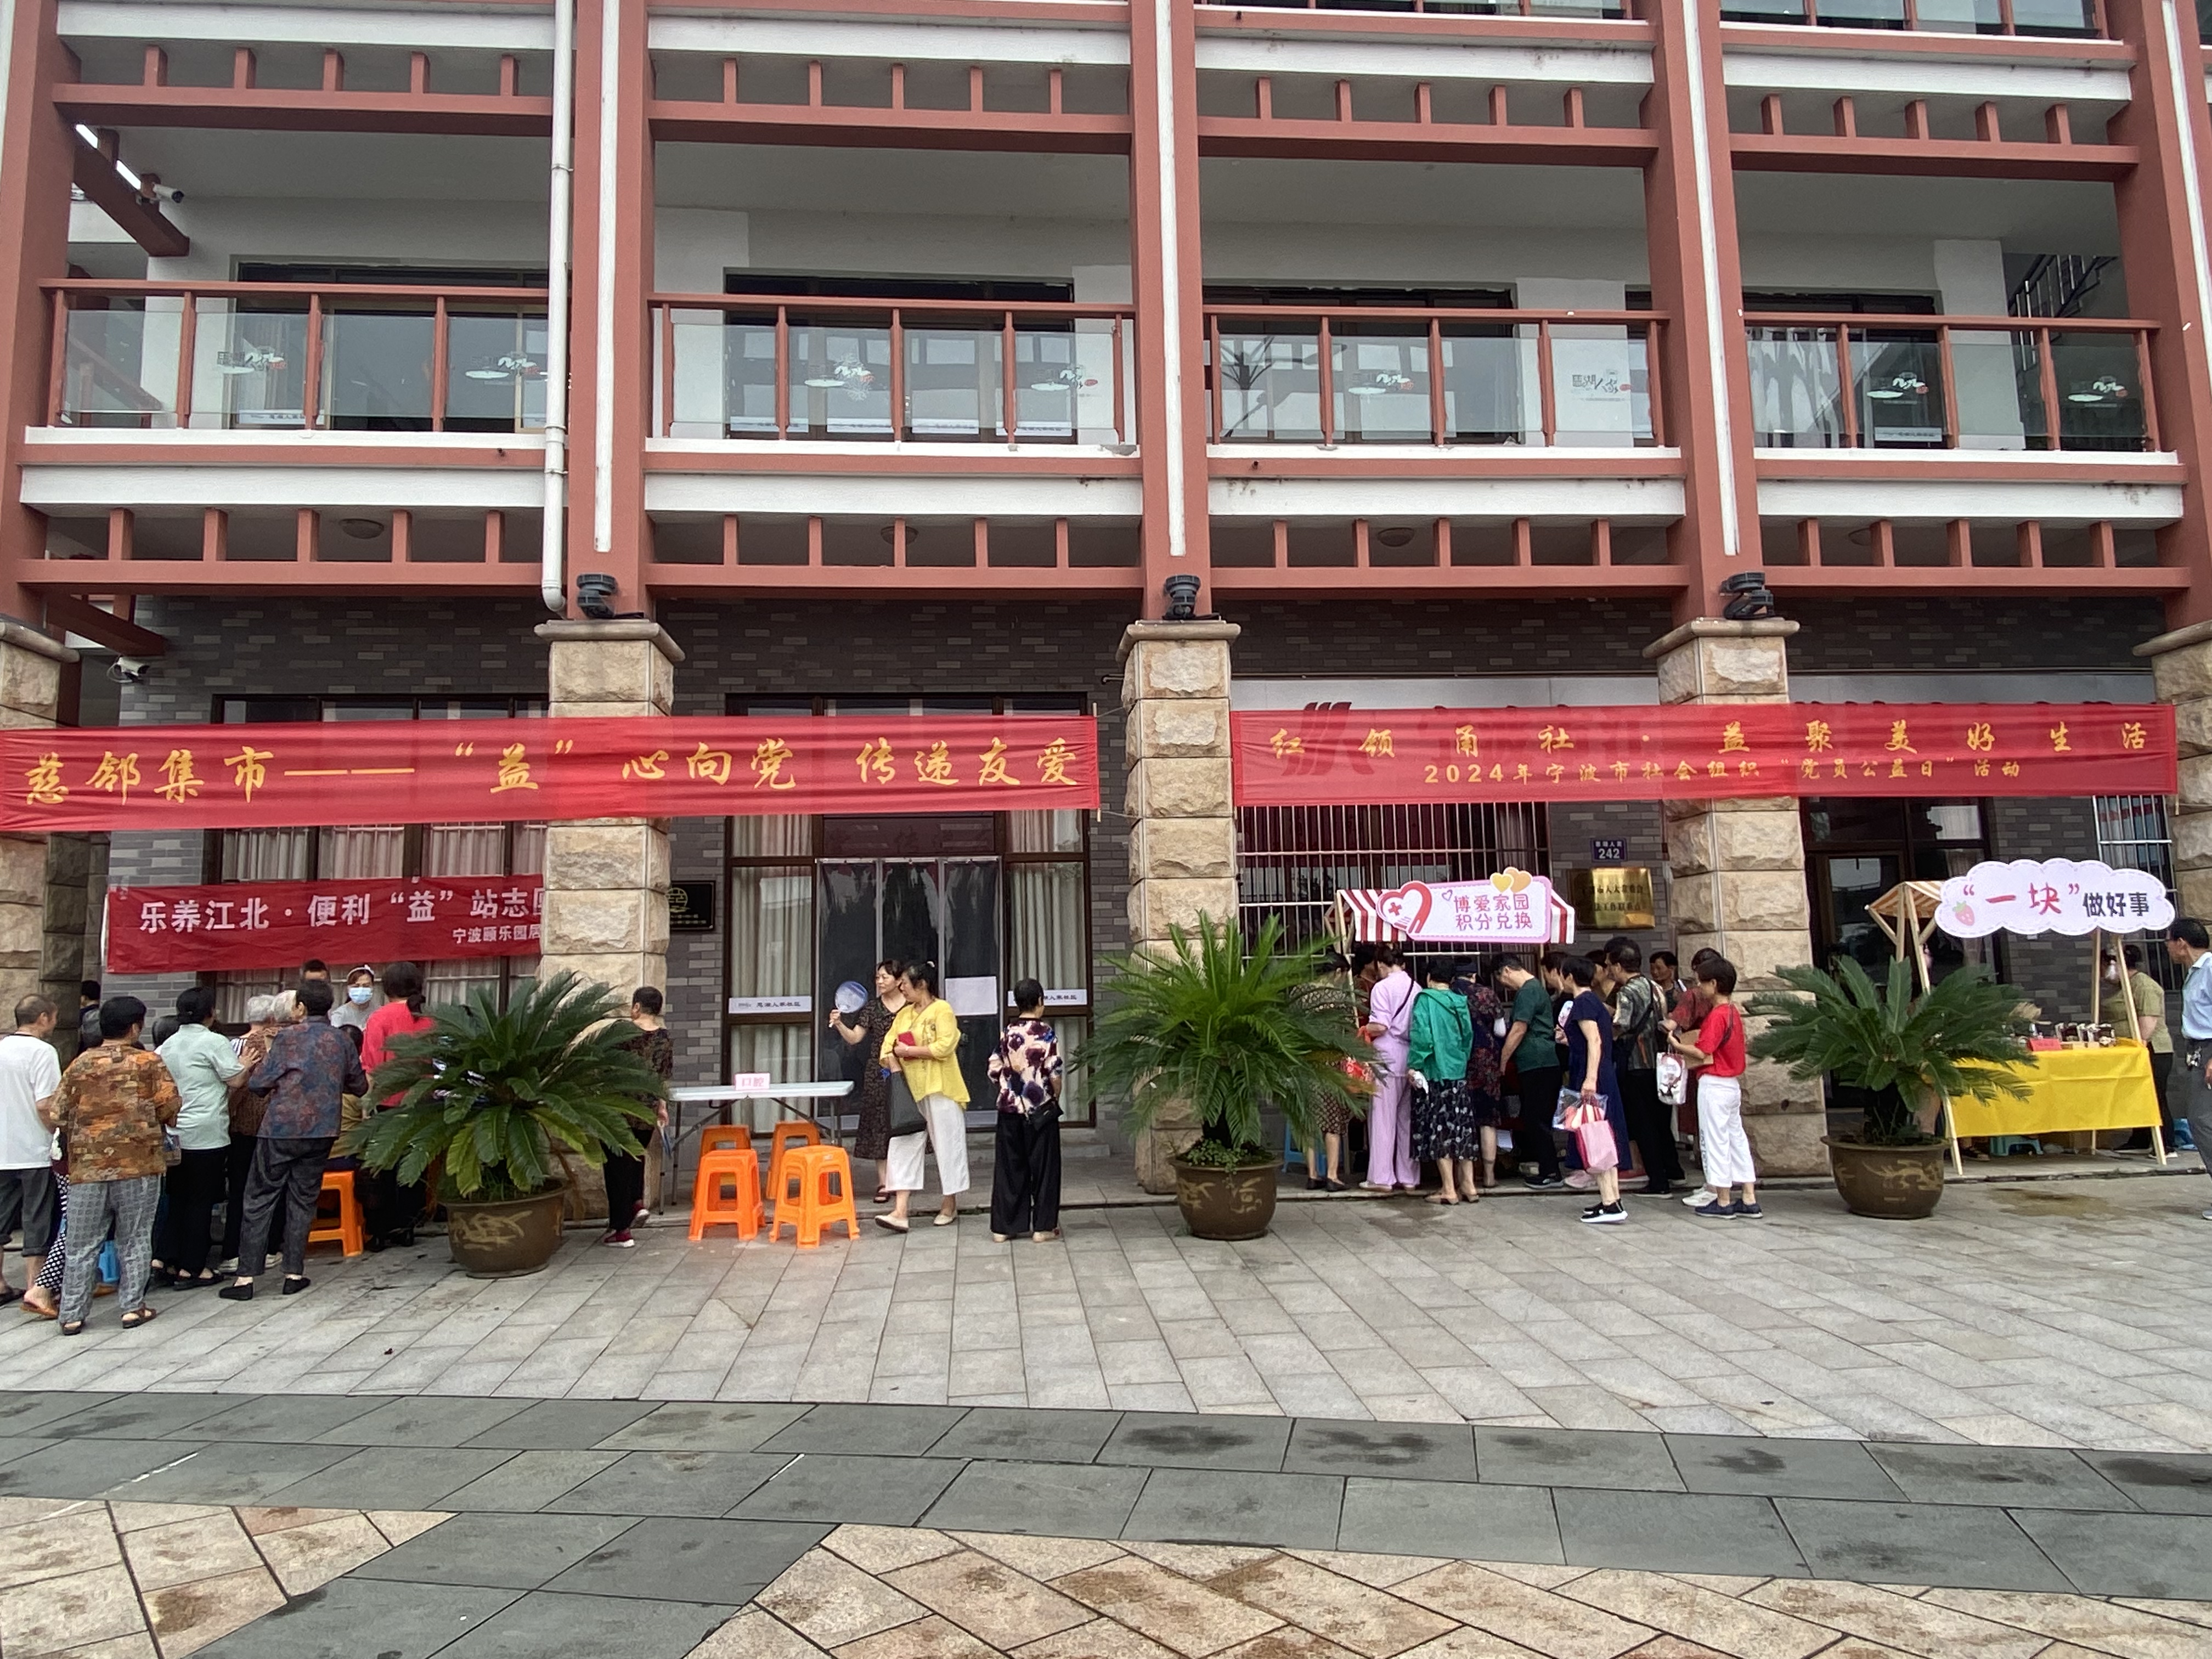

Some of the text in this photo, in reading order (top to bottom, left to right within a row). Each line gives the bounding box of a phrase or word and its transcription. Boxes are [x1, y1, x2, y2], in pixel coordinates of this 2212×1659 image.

[856, 737, 1077, 787] 传递友爱
[1599, 849, 1620, 859] 242
[1454, 894, 1529, 913] 博爱家园
[1457, 911, 1533, 931] 积分兑换
